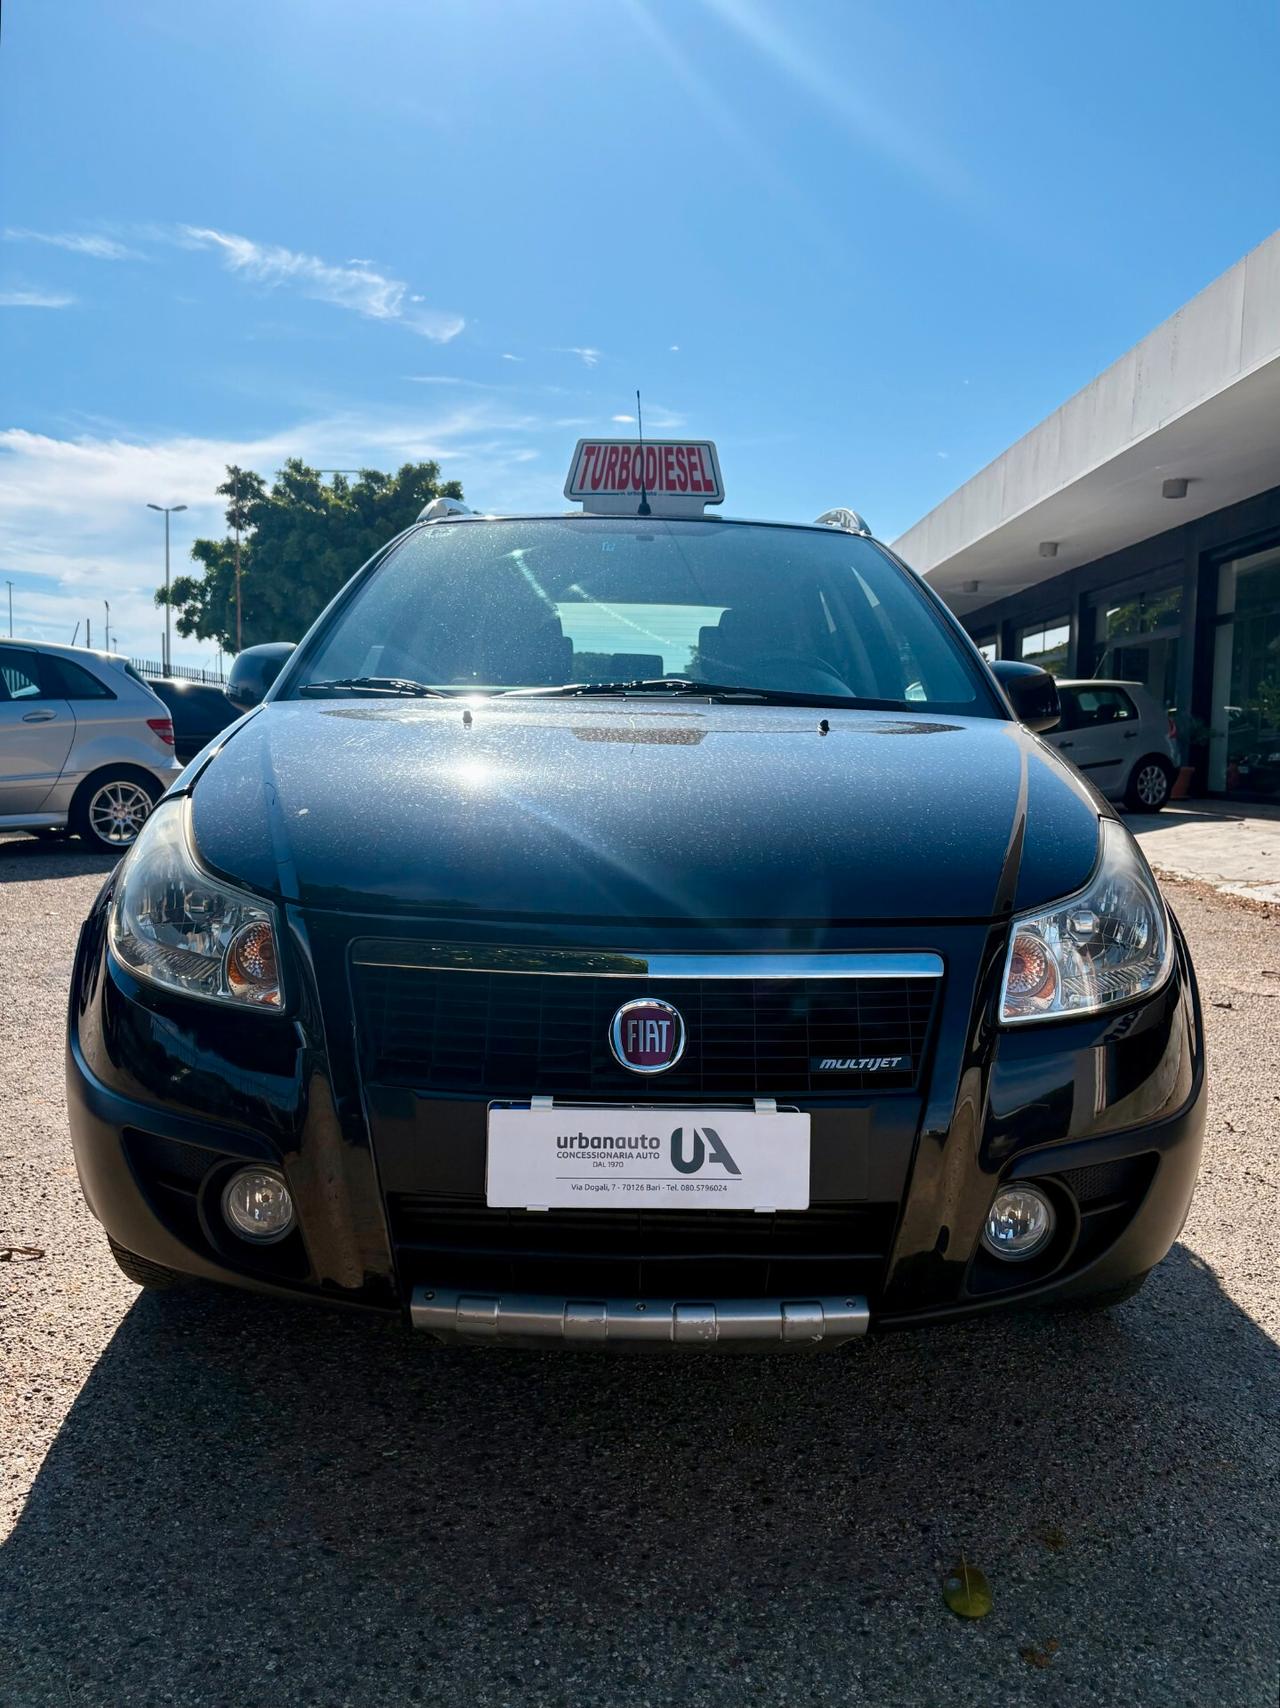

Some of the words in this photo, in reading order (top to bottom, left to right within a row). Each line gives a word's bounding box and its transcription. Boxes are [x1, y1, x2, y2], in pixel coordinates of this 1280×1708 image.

[579, 445, 715, 492] TURBODIESEL
[627, 1019, 671, 1053] FIAT
[819, 1057, 902, 1071] MULTIJET
[556, 1132, 661, 1149] urbanauto
[556, 1151, 634, 1159] CONCESSIONARIA
[635, 1151, 660, 1159] AUTO
[670, 1127, 742, 1175] UA
[584, 1183, 610, 1192] Dogali,
[680, 1184, 728, 1192] 080.5796024
